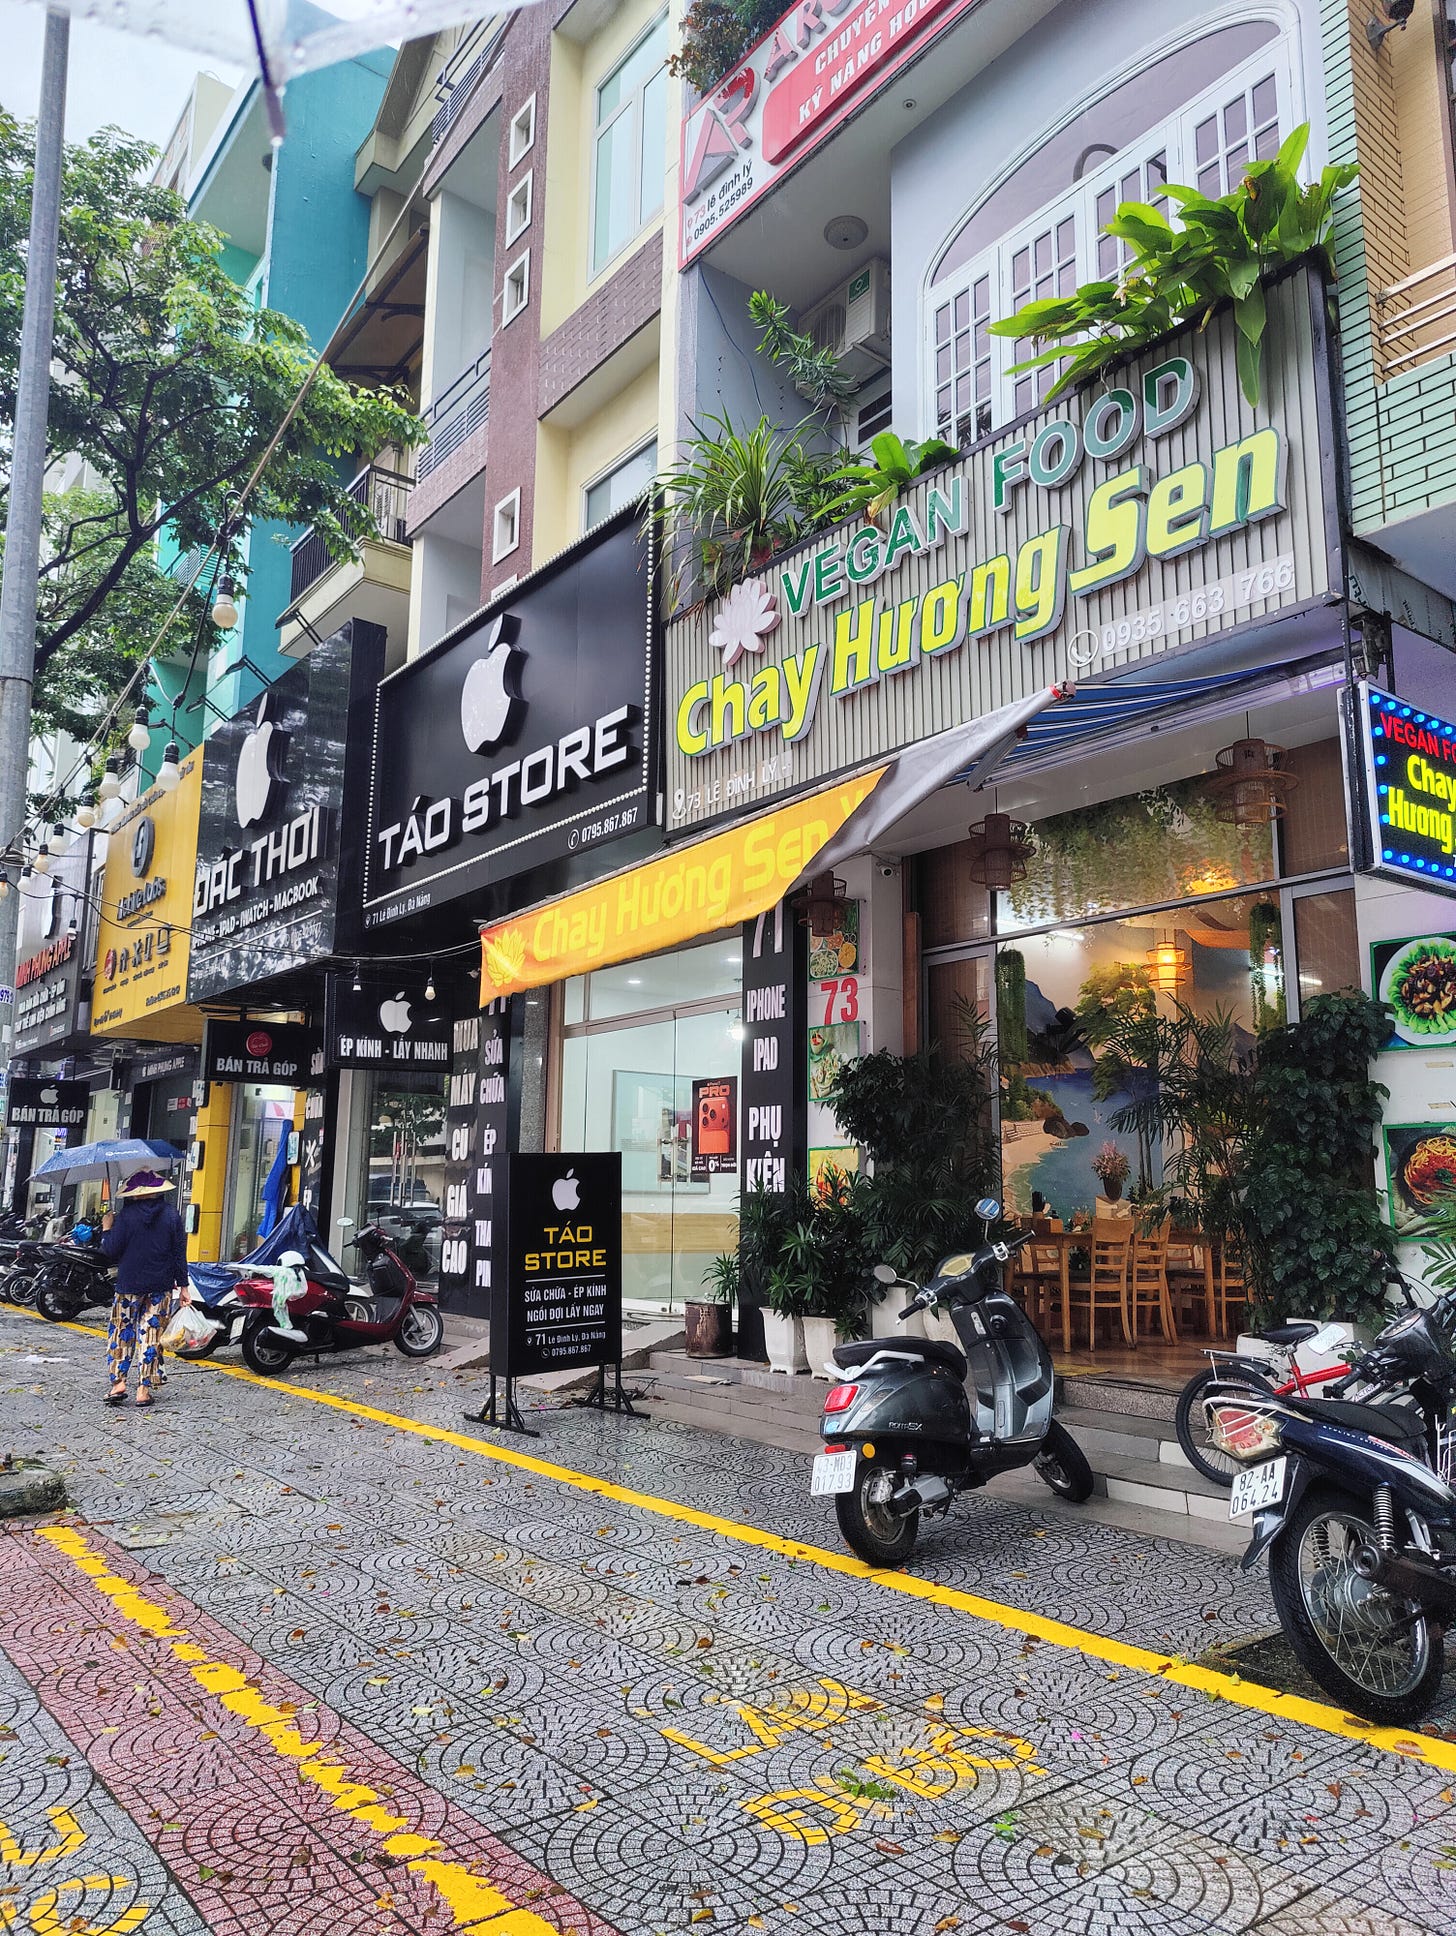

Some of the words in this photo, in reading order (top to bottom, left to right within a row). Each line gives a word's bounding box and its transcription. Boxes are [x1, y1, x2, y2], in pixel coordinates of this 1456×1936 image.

[780, 476, 969, 617] VEGAN
[993, 356, 1200, 512] FOOD
[676, 643, 826, 757] Chay
[830, 523, 1071, 698] Hương
[1069, 427, 1287, 598] Sen
[1102, 609, 1162, 652] 0935
[1174, 586, 1225, 625] 663
[1240, 560, 1292, 600] 766
[1380, 712, 1440, 758] VEGAN
[378, 796, 452, 870] TÁO
[462, 704, 636, 833] STORE
[687, 792, 701, 812] 73
[707, 781, 720, 803] LÊ
[726, 771, 755, 797] ĐÌNH
[762, 756, 777, 782] LÝ
[1406, 754, 1456, 812] Chay
[581, 807, 638, 842] 0795.867.867
[274, 876, 319, 912] MACBOOK
[533, 903, 608, 962] Chay
[616, 855, 732, 934] Hương
[744, 819, 828, 892] Sen
[372, 912, 379, 925] 71
[746, 984, 786, 1023] IPHONE
[820, 977, 859, 1025] 73
[340, 1034, 353, 1057] ÉP
[356, 1036, 382, 1058] KÍNH
[393, 1035, 411, 1059] LẤY
[414, 1041, 448, 1061] NHANH
[453, 1018, 479, 1053] MUA
[484, 1029, 503, 1065] SỬA
[216, 1056, 243, 1073] BÁN
[246, 1057, 269, 1075] TRẢ
[273, 1060, 298, 1077] GÓP
[753, 1036, 778, 1072] IPAD
[450, 1069, 476, 1107] MÁY
[480, 1072, 504, 1104] CHỮA
[698, 1084, 730, 1098] PRO
[11, 1104, 37, 1122] BÁN
[38, 1104, 60, 1123] TRẢ
[60, 1104, 84, 1124] GÓP
[748, 1105, 782, 1147] PHỤ
[451, 1123, 469, 1161] CŨ
[483, 1123, 496, 1155] ÉP
[476, 1162, 492, 1194] KÍN
[446, 1179, 467, 1217] GIÁ
[475, 1220, 492, 1247] THA
[543, 1220, 593, 1245] TÁO
[441, 1239, 467, 1274] CAO
[524, 1249, 607, 1271] STORE
[524, 1286, 541, 1303] SỬA
[543, 1285, 566, 1301] CHỮA
[573, 1284, 585, 1299] ÉP
[586, 1283, 607, 1297] KÍNH
[549, 1307, 564, 1322] ĐỢI
[565, 1302, 581, 1318] LẤY
[583, 1303, 604, 1317] NGAY
[535, 1333, 546, 1345] 71
[814, 1473, 851, 1492] 017.93
[1240, 1463, 1275, 1491] 82-AA
[1232, 1481, 1277, 1514] 064.24
